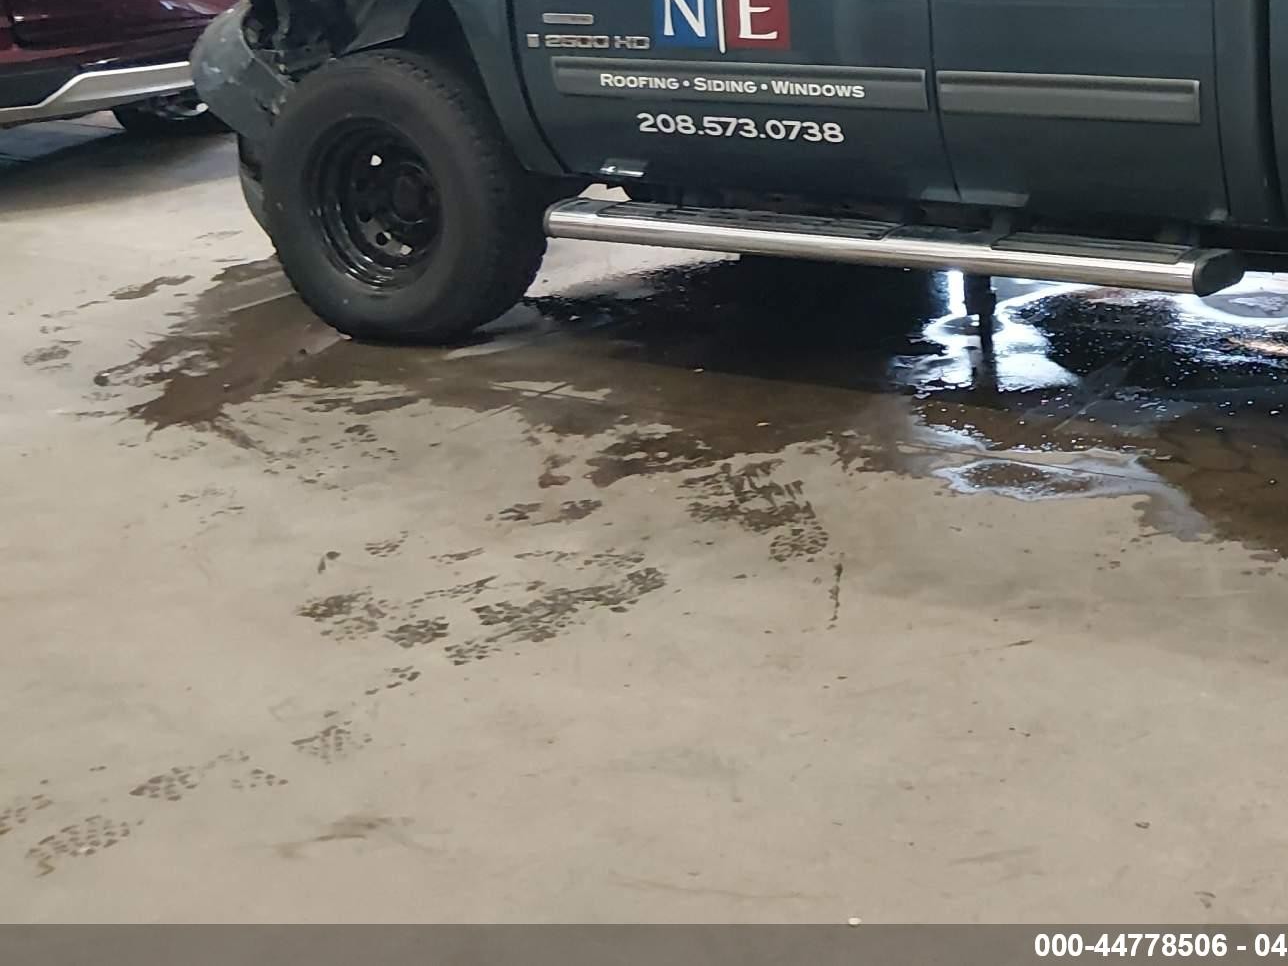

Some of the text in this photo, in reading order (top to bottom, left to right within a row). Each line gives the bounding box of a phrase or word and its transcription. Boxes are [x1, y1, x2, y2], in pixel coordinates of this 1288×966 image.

[544, 34, 610, 48] 2500
[614, 35, 650, 49] HD
[600, 73, 865, 98] ROOFING SIDING WINDOWS
[636, 112, 845, 143] 208.573.0738
